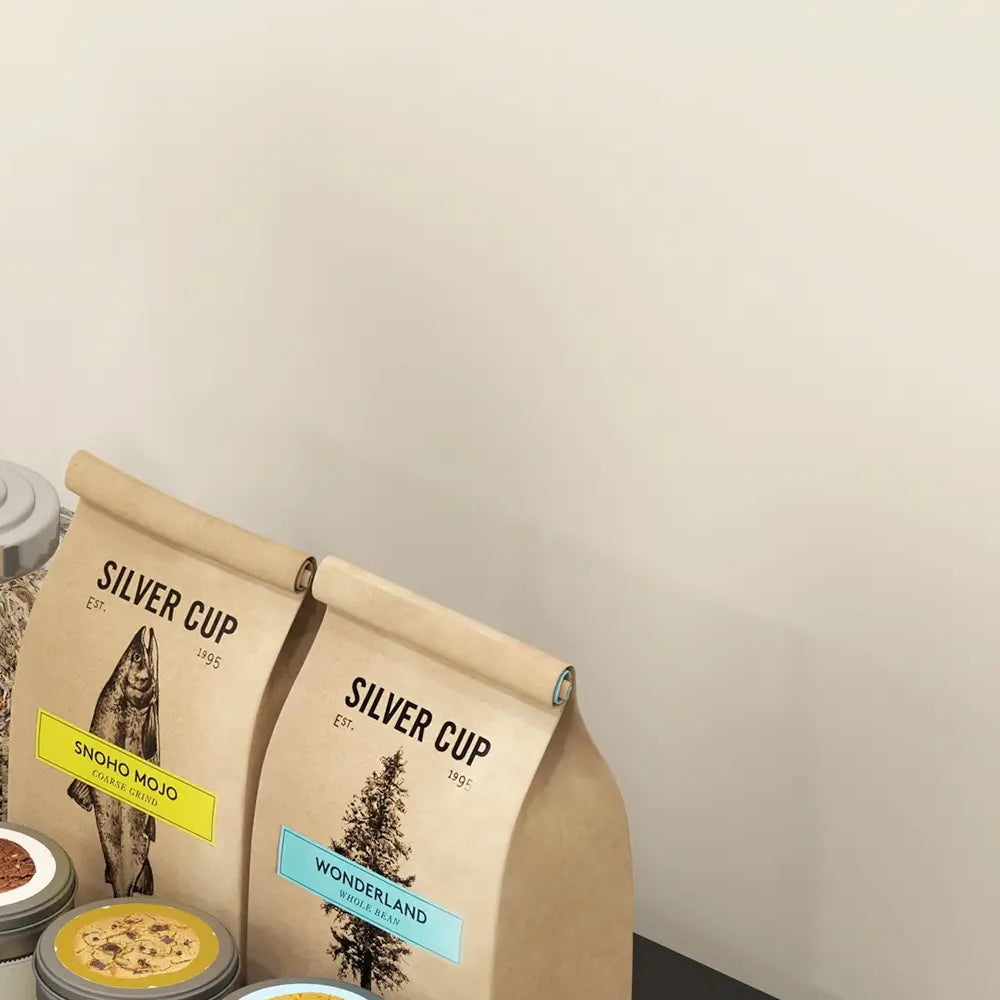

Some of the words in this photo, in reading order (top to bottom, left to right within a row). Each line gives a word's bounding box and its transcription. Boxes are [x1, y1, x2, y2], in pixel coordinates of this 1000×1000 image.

[86, 596, 107, 613] EST.
[97, 560, 182, 622] SILVER
[184, 600, 238, 644] CUP
[197, 647, 222, 669] 1995
[333, 713, 355, 731] EST.
[344, 676, 433, 743] SILVER
[434, 720, 492, 767] CUP
[74, 740, 130, 778] SNOHO
[134, 769, 178, 801] MOJO
[92, 769, 127, 792] COARSE
[129, 786, 158, 807] GRIND
[447, 769, 474, 793] 1995
[315, 856, 428, 925] WONDERLAND
[339, 889, 372, 913] WHOLE
[374, 907, 401, 927] BEAN
